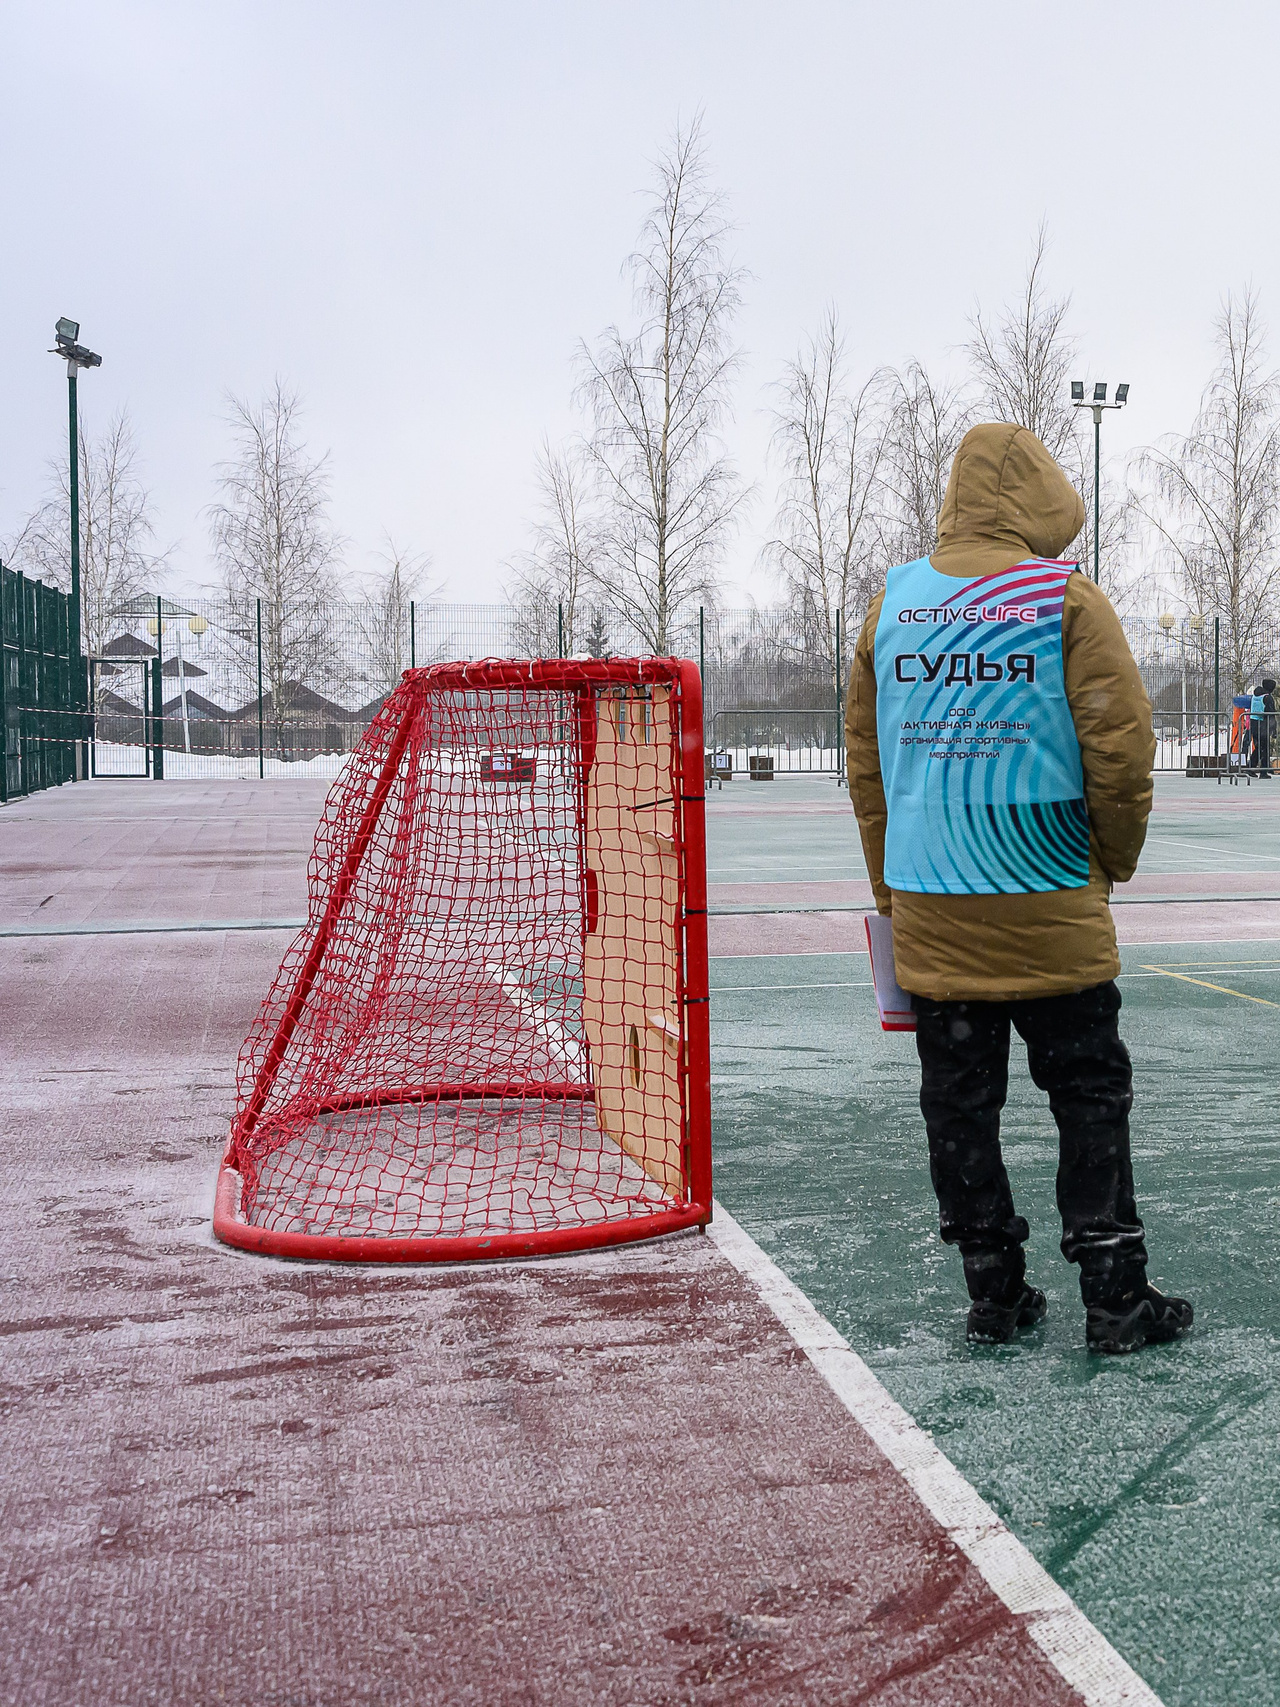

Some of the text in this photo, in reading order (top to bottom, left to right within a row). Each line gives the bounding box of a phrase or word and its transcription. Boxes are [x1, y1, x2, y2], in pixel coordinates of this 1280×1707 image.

[982, 606, 1036, 623] LIFE
[895, 652, 1036, 687] СУДЬЯ
[948, 708, 976, 717] ООО
[899, 737, 1031, 746] организация спортивных
[929, 749, 1000, 760] мероприятий
